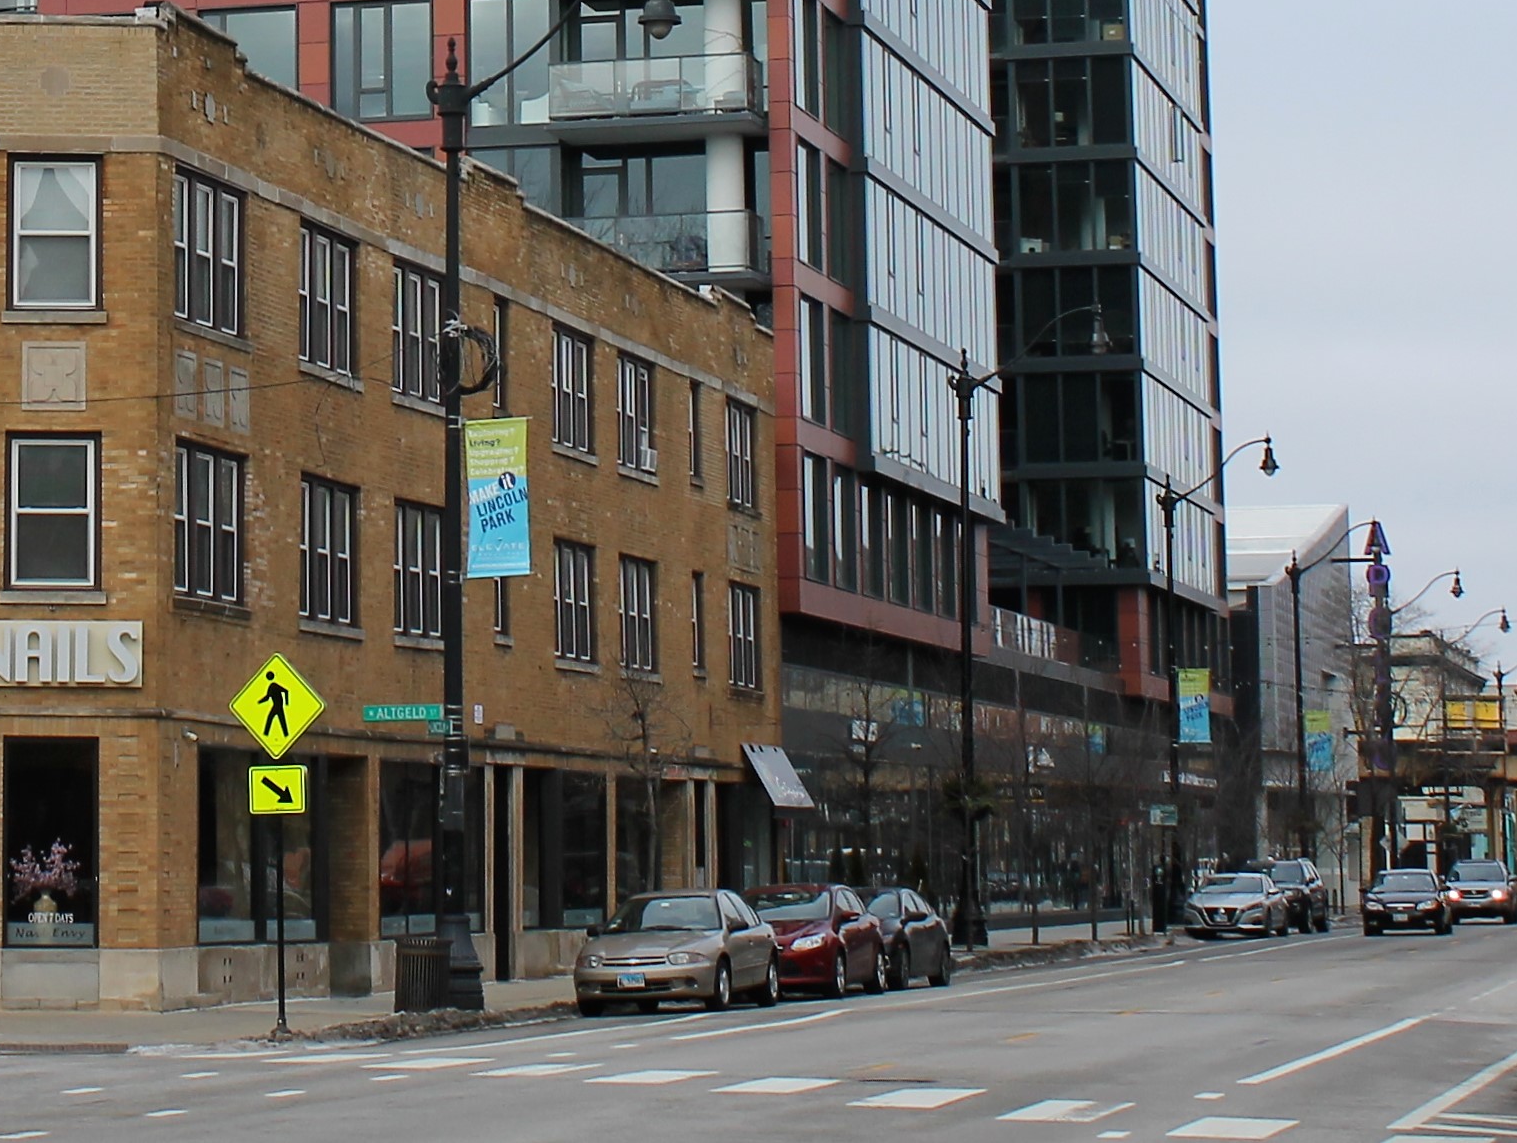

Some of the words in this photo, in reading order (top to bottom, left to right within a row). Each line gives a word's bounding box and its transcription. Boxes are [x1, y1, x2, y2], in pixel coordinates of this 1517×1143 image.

[469, 439, 500, 448] Living?
[469, 482, 500, 505] MAKE
[500, 472, 514, 490] it
[476, 486, 528, 518] LINCOLN
[480, 509, 516, 533] PARK
[376, 707, 427, 719] ALTGELD
[27, 912, 47, 923] OPEN
[55, 913, 74, 923] DAYS
[52, 927, 86, 940] Envy
